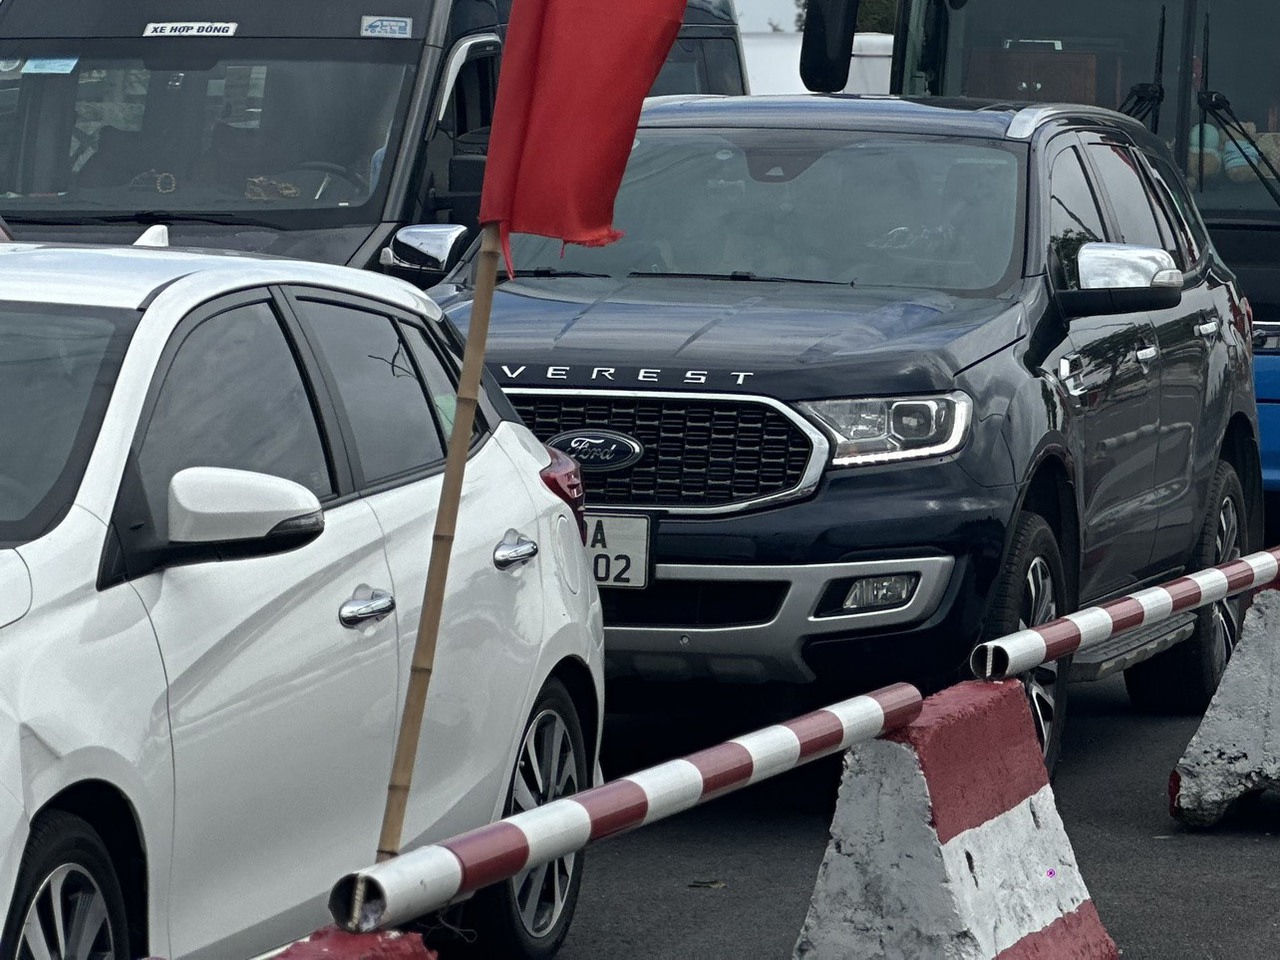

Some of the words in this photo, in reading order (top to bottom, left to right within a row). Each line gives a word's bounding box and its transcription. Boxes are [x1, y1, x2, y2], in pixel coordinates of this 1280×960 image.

[501, 365, 754, 385] VEREST
[567, 437, 617, 461] Ford
[582, 519, 607, 548] A
